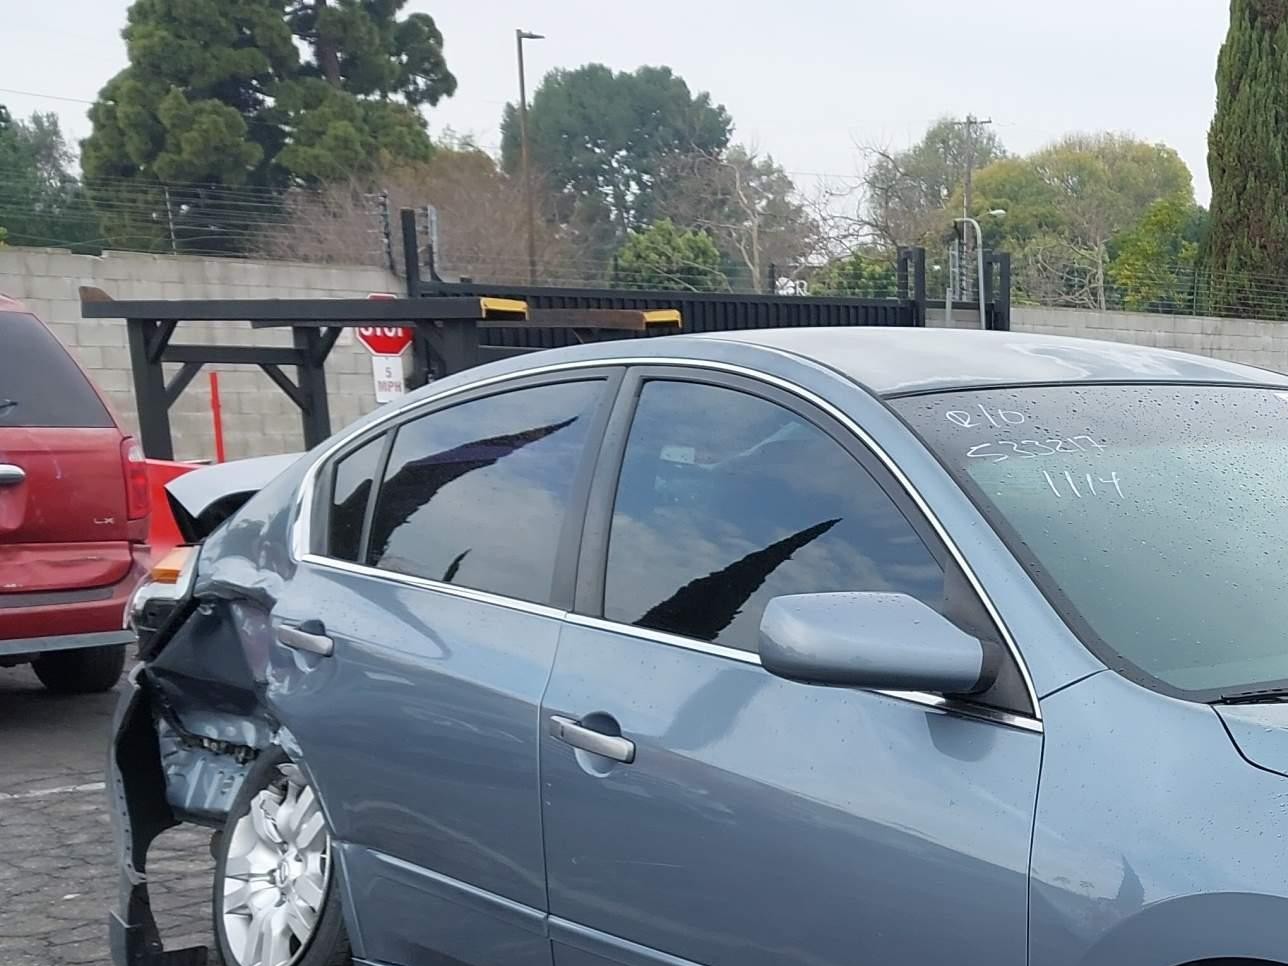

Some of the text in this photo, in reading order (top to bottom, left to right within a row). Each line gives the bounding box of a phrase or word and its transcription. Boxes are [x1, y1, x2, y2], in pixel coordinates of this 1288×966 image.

[384, 366, 393, 378] 5
[377, 380, 402, 393] MPH
[93, 517, 115, 525] LX
